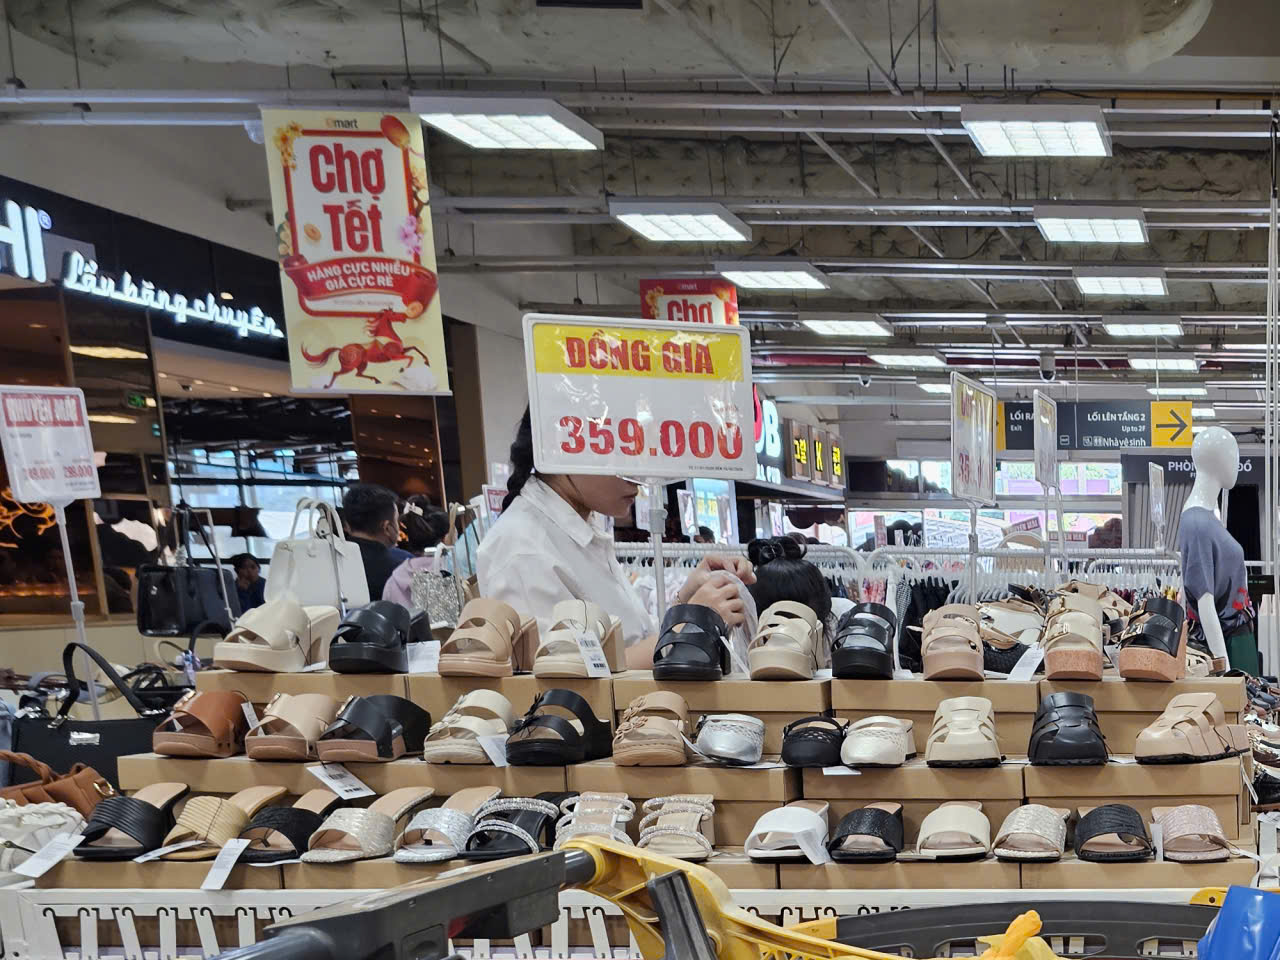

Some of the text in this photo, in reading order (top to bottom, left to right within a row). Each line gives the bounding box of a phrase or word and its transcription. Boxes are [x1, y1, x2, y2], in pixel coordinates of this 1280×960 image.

[309, 142, 386, 200] Chợ
[322, 199, 384, 253] Tết
[307, 264, 341, 282] HÀNG
[342, 262, 370, 274] CỰC
[325, 278, 347, 291] GIÁ
[348, 275, 375, 288] CỰC
[1102, 411, 1117, 421] LÊN
[1140, 413, 1146, 421] 2
[559, 415, 743, 460] 359.000
[1121, 425, 1131, 433] Up
[1103, 437, 1146, 447] Nhà vệ sinh
